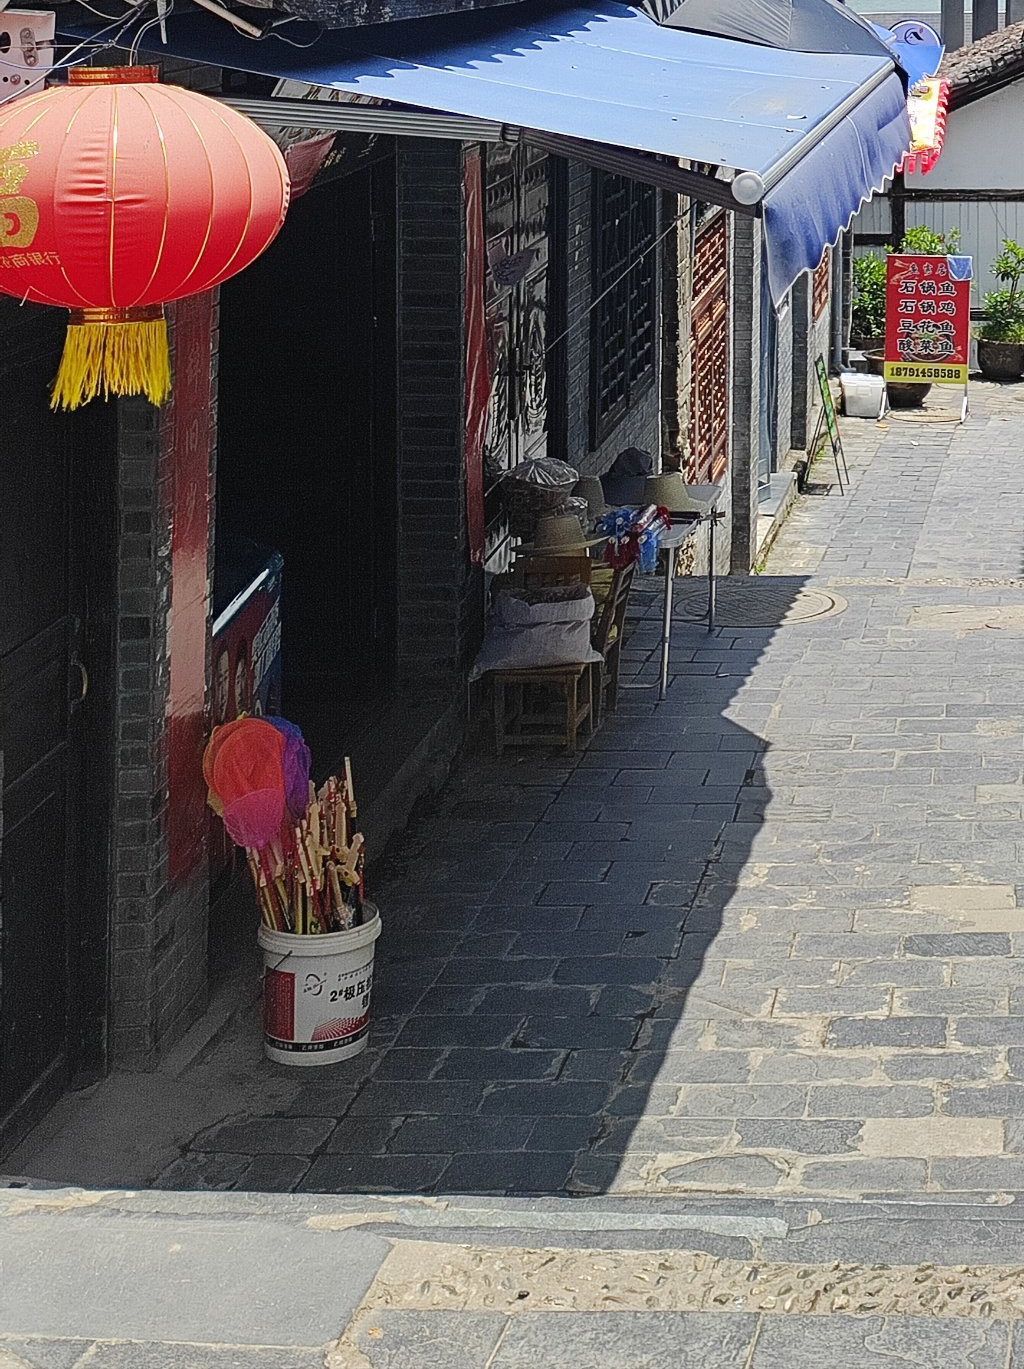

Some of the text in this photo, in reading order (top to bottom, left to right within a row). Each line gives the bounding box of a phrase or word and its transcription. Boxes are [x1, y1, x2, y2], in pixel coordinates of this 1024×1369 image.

[898, 280, 957, 296] 石锅鱼
[898, 300, 956, 316] 石锅鸡
[898, 320, 956, 336] 豆花鱼
[897, 339, 956, 355] 酸菜鱼
[889, 366, 961, 380] 18791458588
